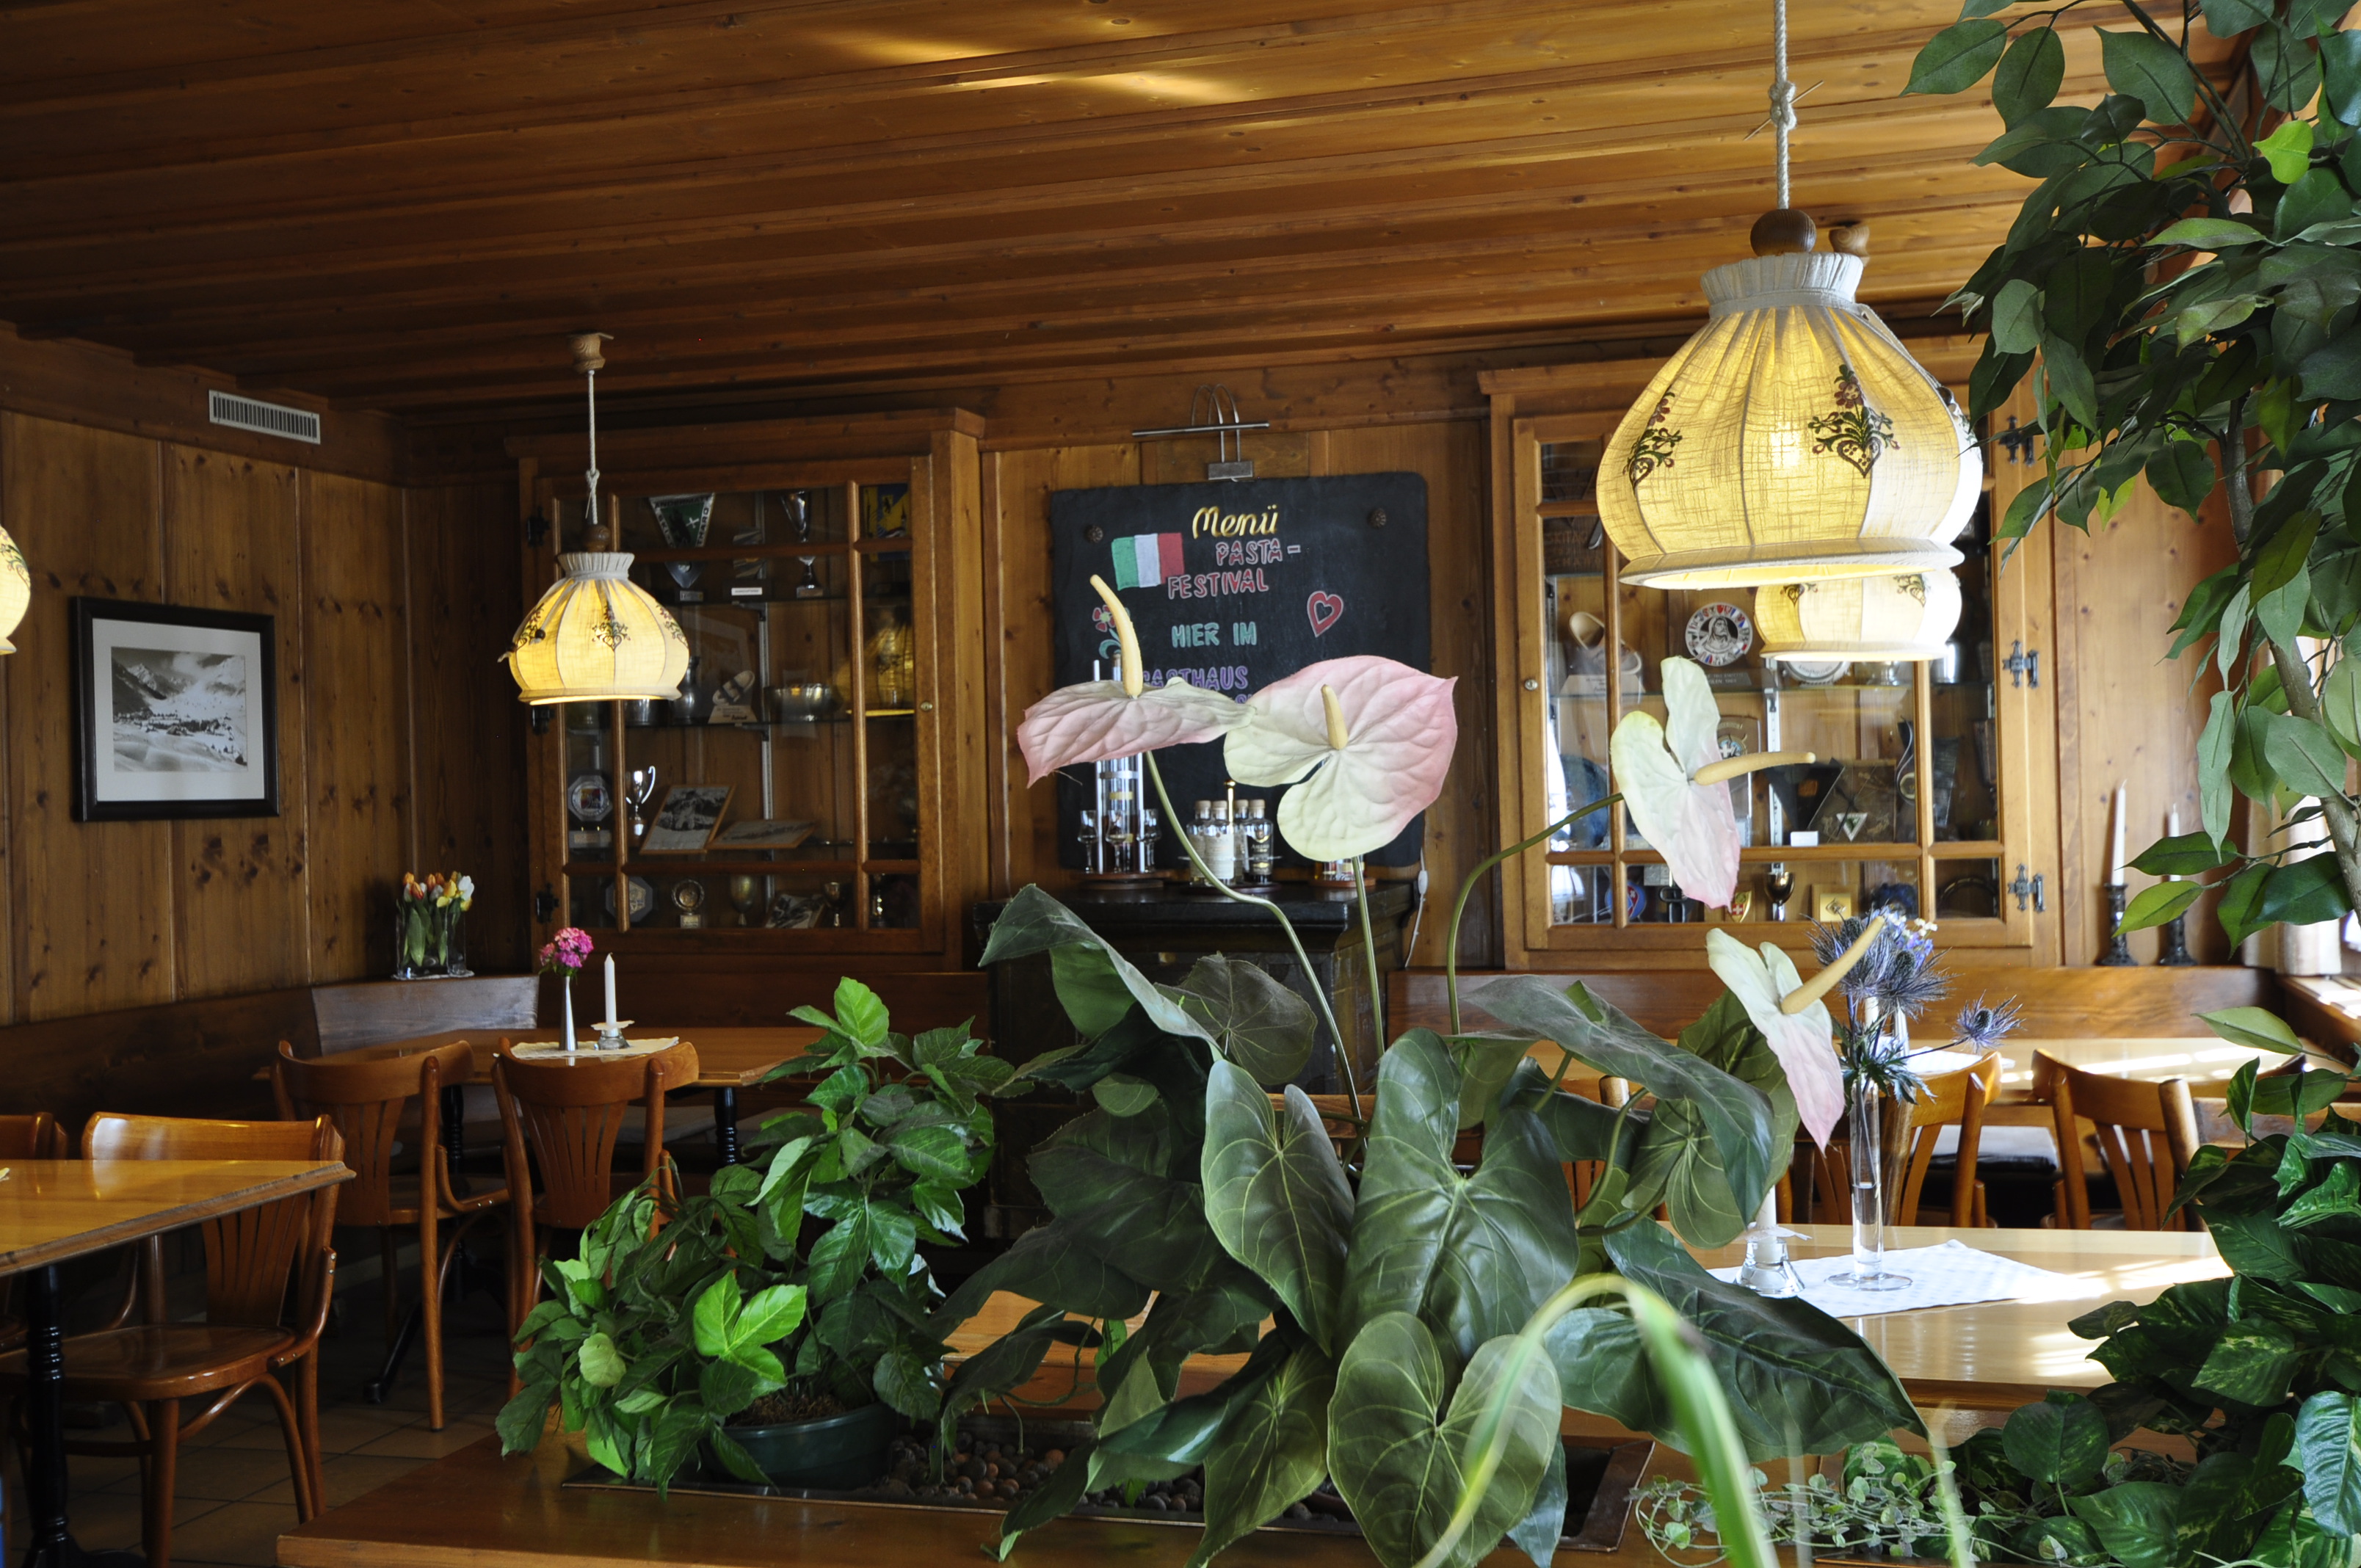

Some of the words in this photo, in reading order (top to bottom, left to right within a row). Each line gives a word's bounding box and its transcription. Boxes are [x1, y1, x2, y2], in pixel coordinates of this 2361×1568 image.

[1192, 504, 1278, 540] Menü
[1216, 538, 1301, 566] PASTA-
[1168, 568, 1268, 599] FESTIVAL
[1172, 622, 1219, 647] HIER
[1233, 622, 1257, 646] IM
